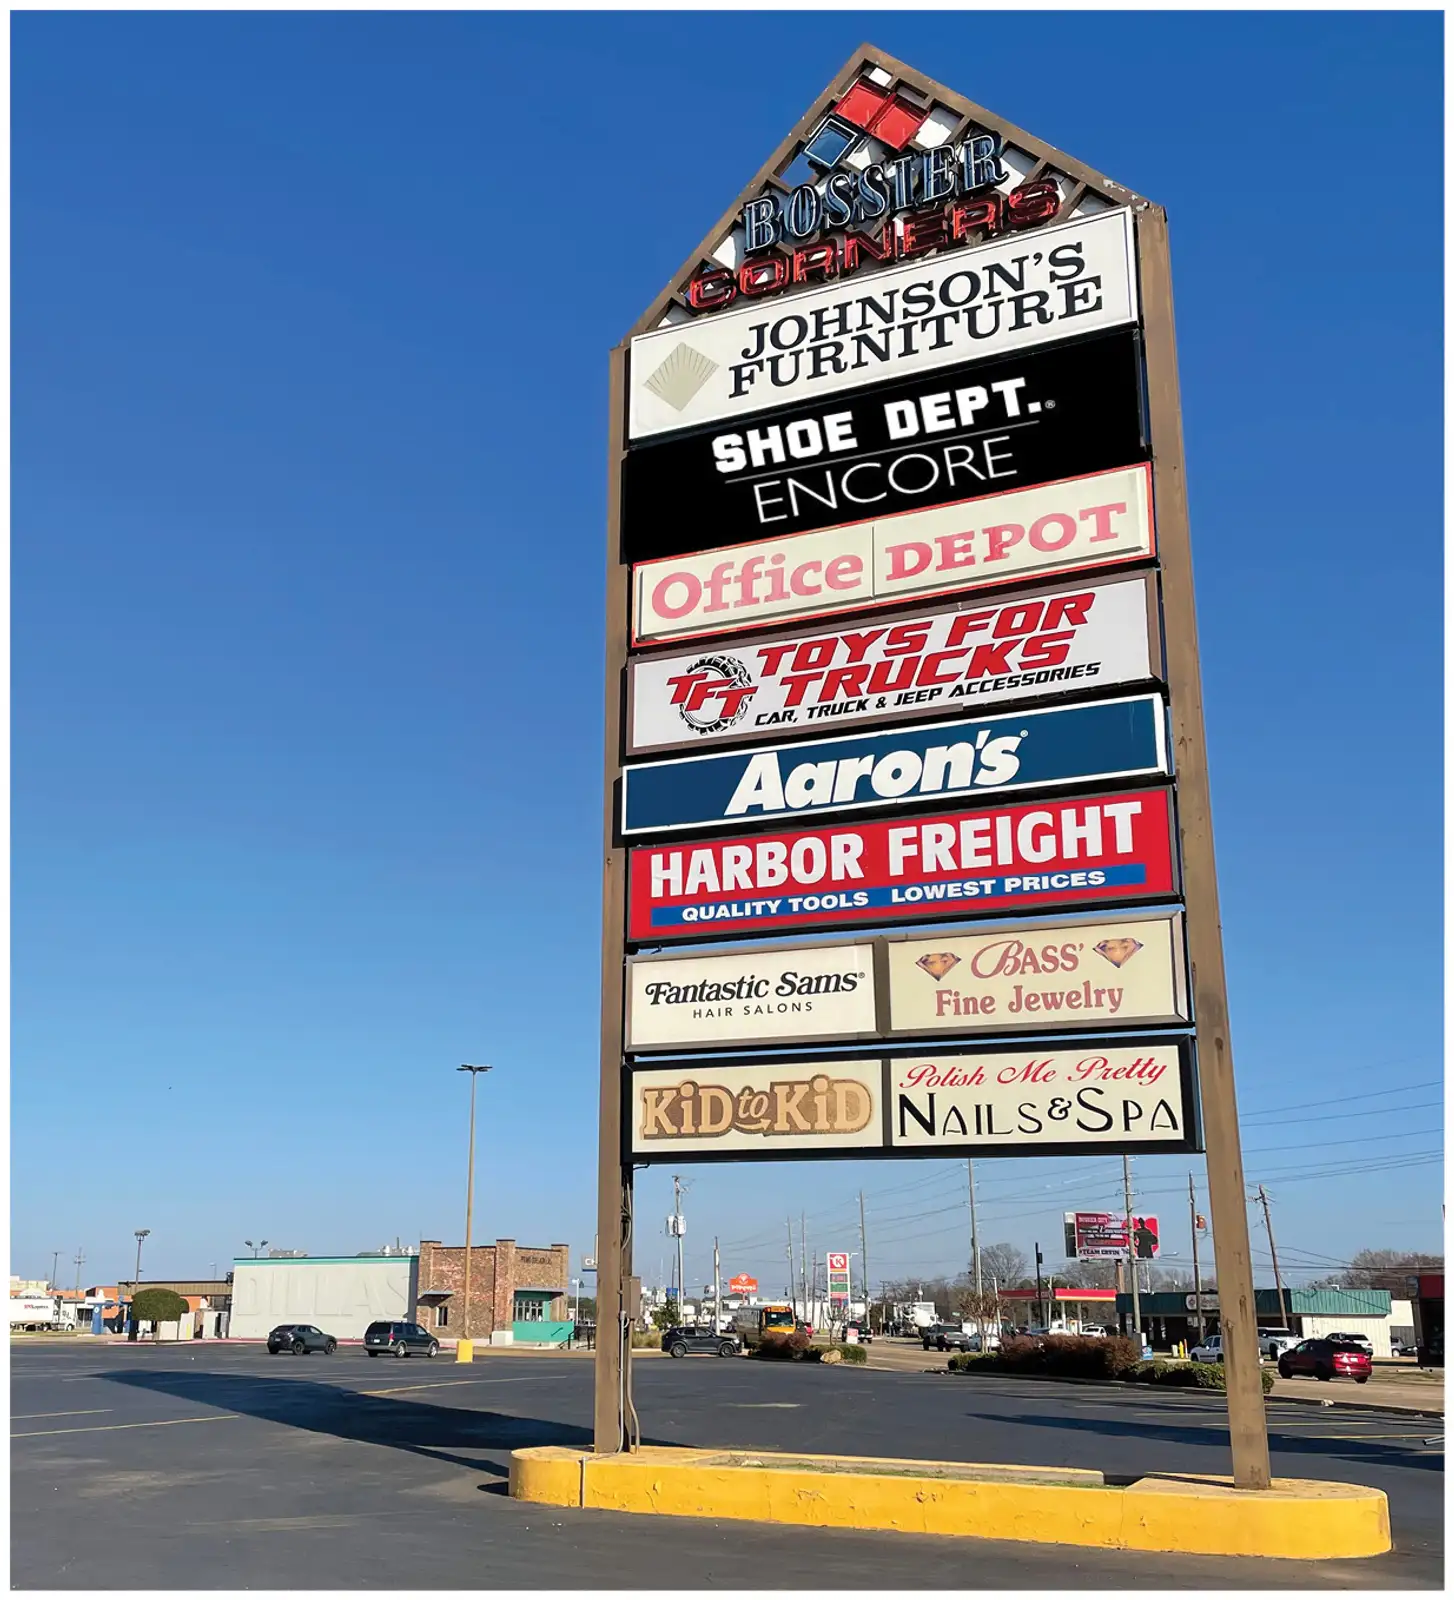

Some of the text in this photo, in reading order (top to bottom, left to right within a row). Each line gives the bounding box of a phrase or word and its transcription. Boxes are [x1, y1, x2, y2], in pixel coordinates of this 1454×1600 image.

[743, 131, 1009, 253] BOSSIER
[688, 178, 1063, 311] CORNERS
[728, 275, 1103, 399] FURNITURE
[741, 242, 1085, 359] JOHNSON'S
[711, 377, 1042, 474] SHOE DEPT.
[753, 435, 1018, 524] ENCORE
[650, 502, 1127, 620] Office DEPOT
[756, 592, 1095, 678] TOYS FOR
[778, 629, 1077, 708] TRUCKS
[666, 672, 759, 718] TFT
[754, 662, 1100, 726] CAR, TRUCK & JEEP ACCESSORIES
[723, 729, 1023, 816] Aaron's
[650, 801, 1142, 898] HARBOR FREIGHT
[681, 870, 1106, 922] QUALITY TOOLS LOWEST PRICES
[644, 970, 859, 1006] Fantastic Sams
[935, 984, 1124, 1017] Fine Jewelry
[970, 940, 1085, 979] BASS'
[692, 1001, 813, 1019] HAIR SALONS
[738, 1089, 769, 1118] to
[899, 1054, 1168, 1089] Polish Me Pretty
